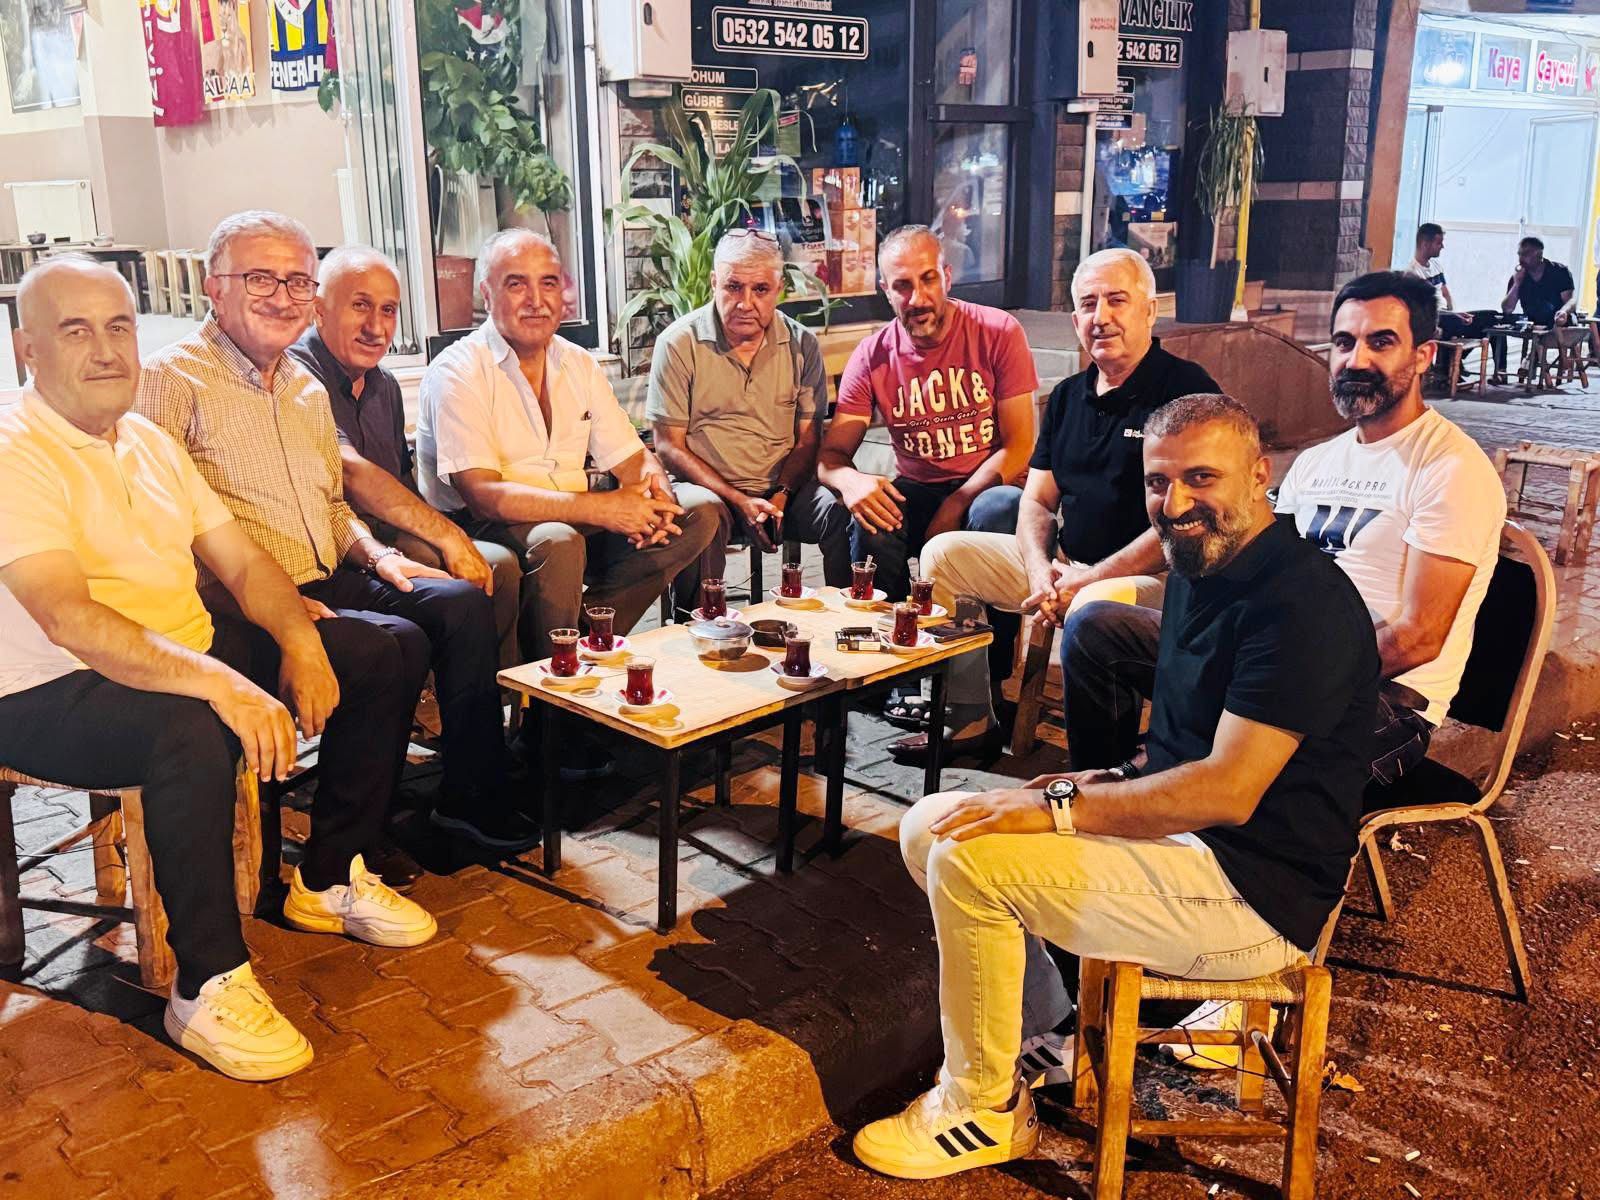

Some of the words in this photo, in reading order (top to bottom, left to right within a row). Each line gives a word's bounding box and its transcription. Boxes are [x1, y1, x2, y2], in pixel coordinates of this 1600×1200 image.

[722, 17, 769, 45] 0532
[774, 21, 808, 47] 542
[812, 24, 834, 49] 05
[839, 26, 860, 50] 12
[1126, 42, 1146, 60] 542
[1148, 43, 1162, 61] 05
[1164, 44, 1177, 61] 12
[1488, 47, 1522, 87] Kaya
[689, 70, 725, 84] OHUM
[684, 92, 724, 107] GÜBRE
[903, 418, 995, 459] JONES
[1364, 481, 1387, 492] PRO
